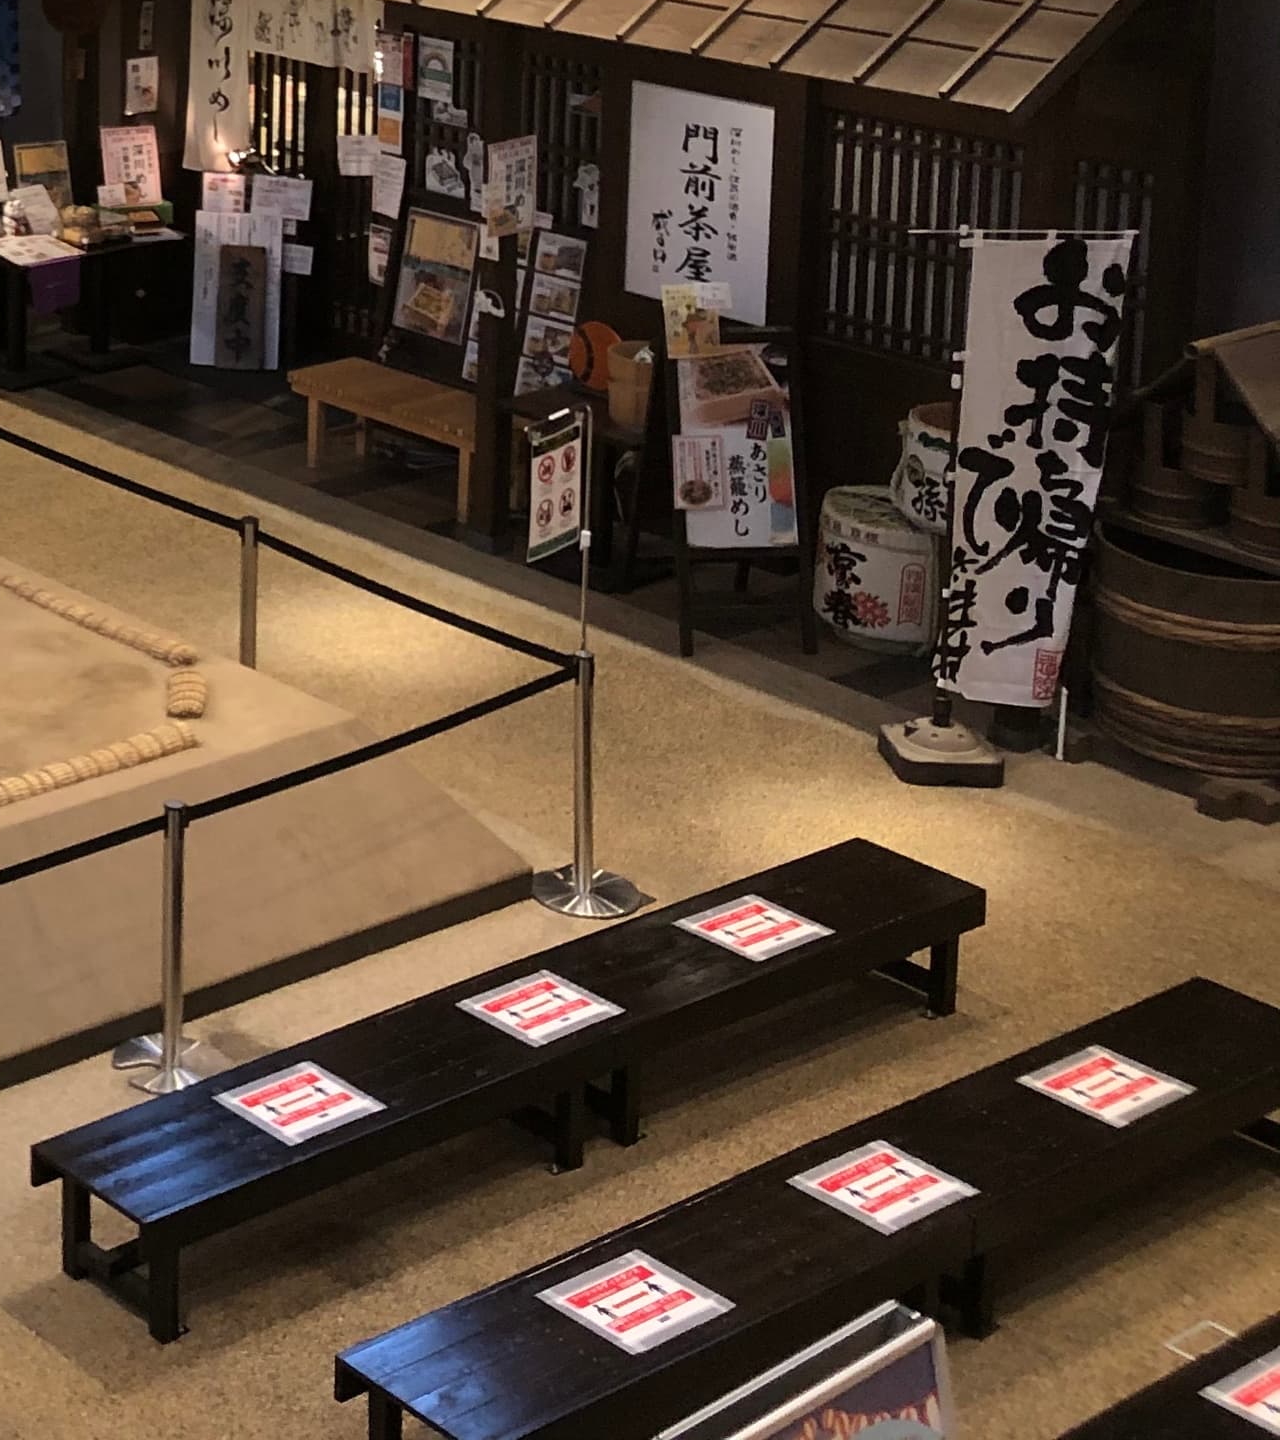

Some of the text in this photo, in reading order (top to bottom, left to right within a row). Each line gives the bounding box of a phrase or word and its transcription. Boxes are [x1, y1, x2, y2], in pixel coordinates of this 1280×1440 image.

[675, 122, 722, 283] 門前茶屋
[728, 454, 750, 537] 蒸籠めし
[750, 443, 767, 504] あさり
[976, 238, 1125, 654] お持ち帰り
